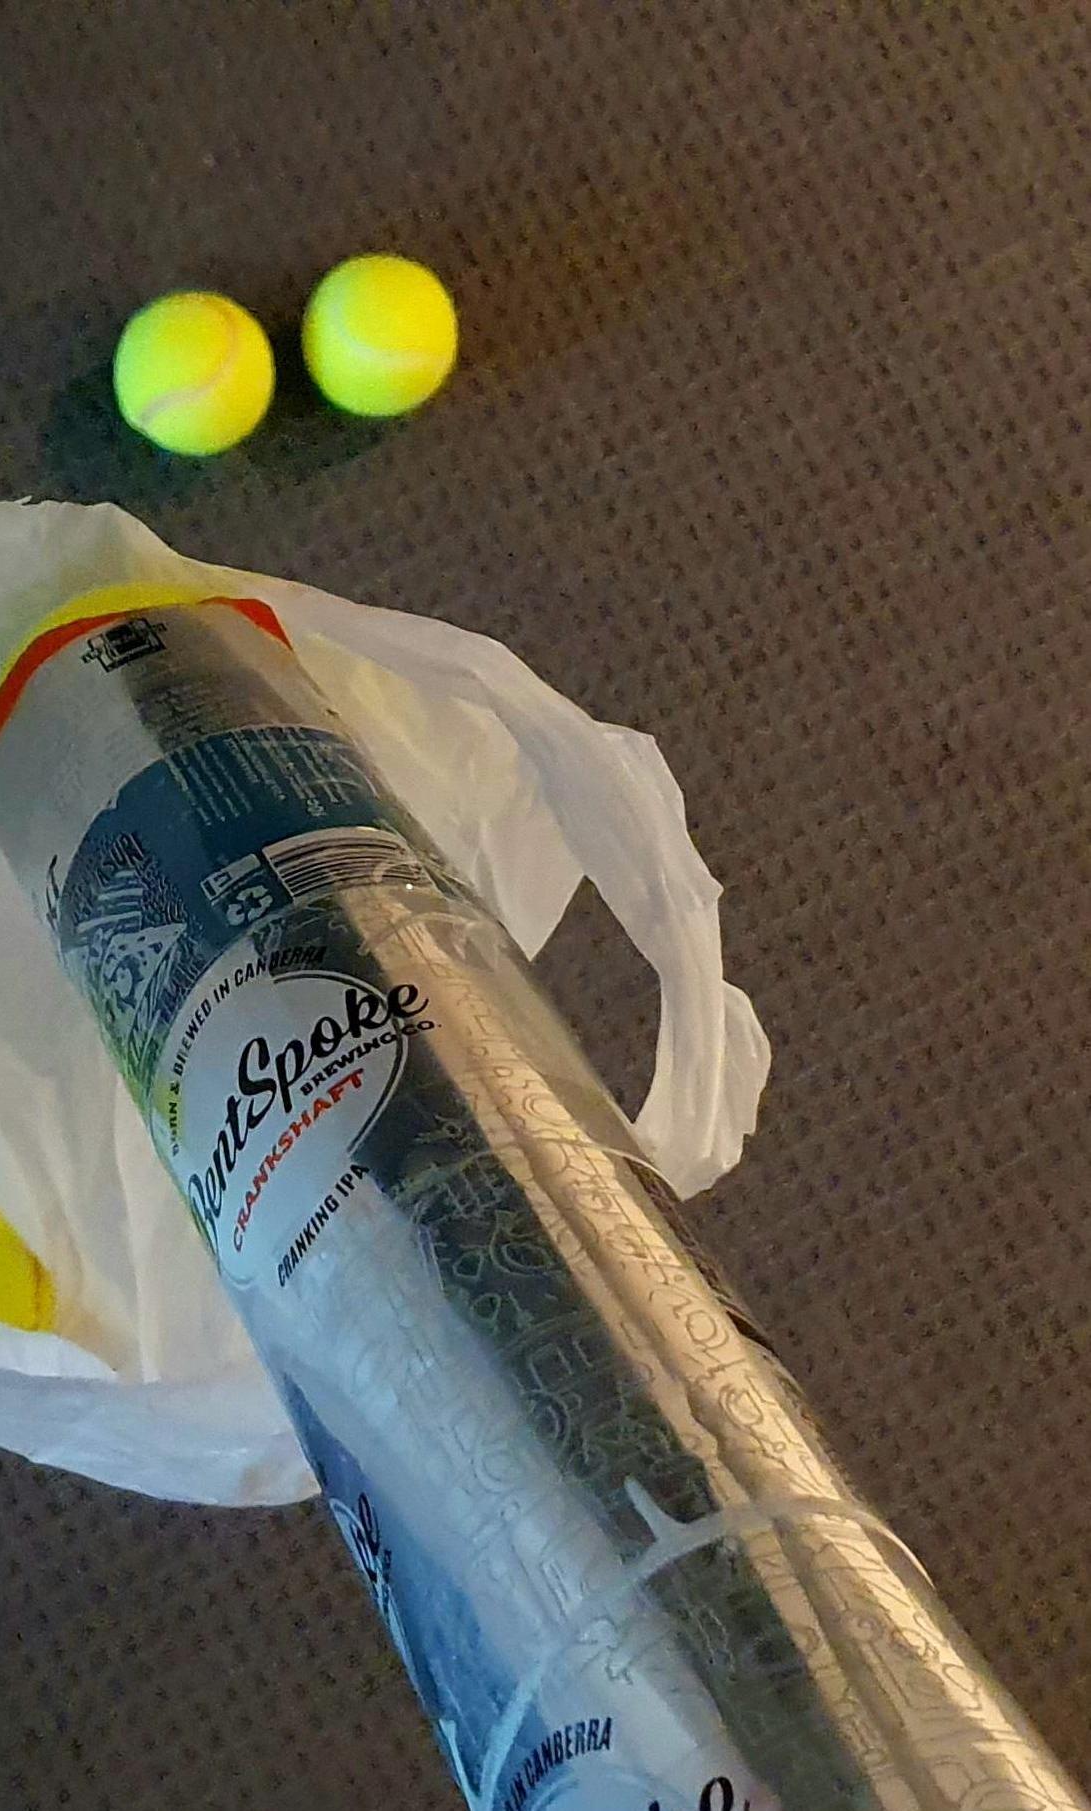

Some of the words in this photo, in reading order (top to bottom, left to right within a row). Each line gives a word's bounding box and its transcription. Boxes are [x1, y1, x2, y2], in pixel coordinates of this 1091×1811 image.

[173, 997, 213, 1078] BREWED
[212, 977, 231, 1004] IN
[233, 945, 327, 989] CANBERRA
[299, 1031, 397, 1097] BREWING
[233, 1067, 365, 1252] CRANKSHAFT
[277, 1193, 341, 1288] CRANKING
[334, 1163, 371, 1198] IPA
[524, 1716, 613, 1790] CANBERRA
